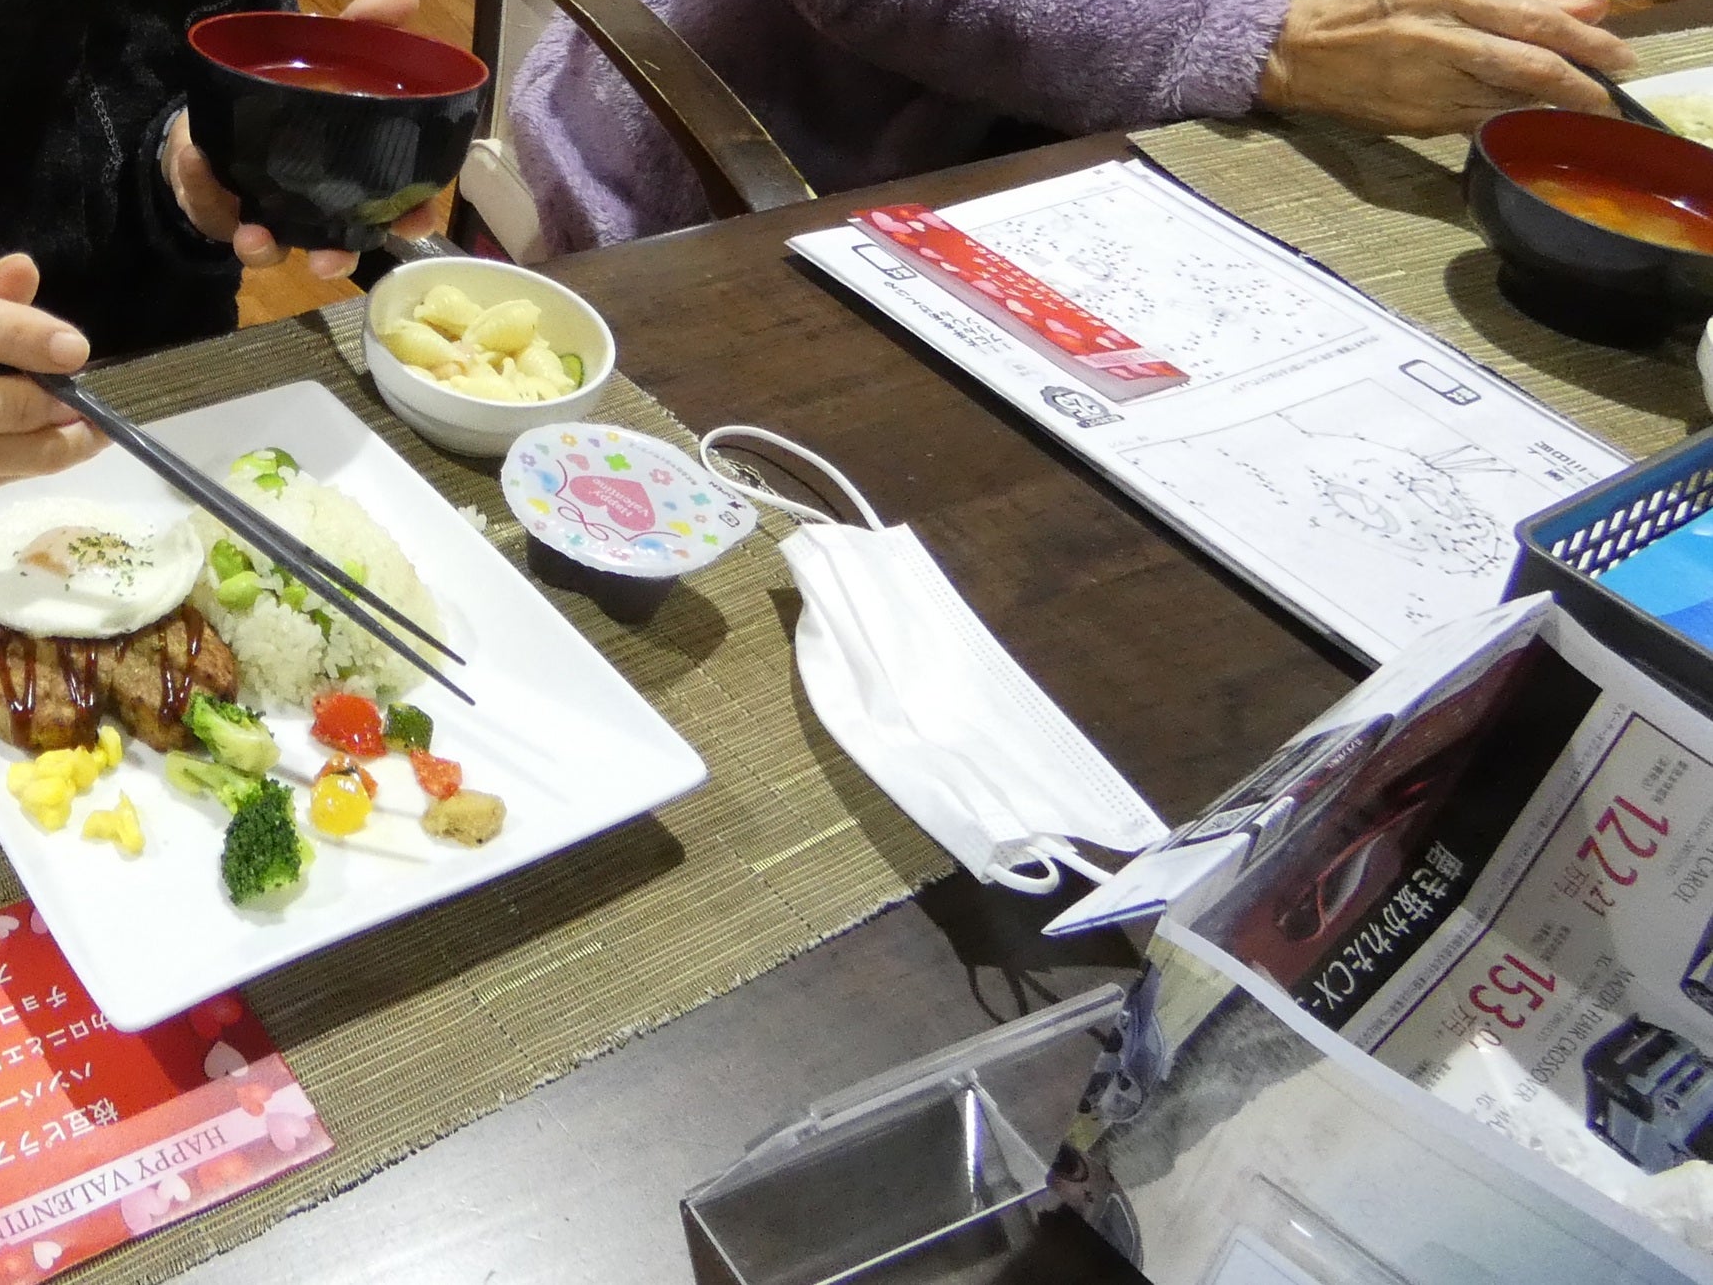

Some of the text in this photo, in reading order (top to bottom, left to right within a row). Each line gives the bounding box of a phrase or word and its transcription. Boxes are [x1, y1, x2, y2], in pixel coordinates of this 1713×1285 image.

[708, 481, 736, 500] OPEN
[1591, 964, 1634, 1013] MAZDA
[1513, 1034, 1577, 1103] CROSSOVER
[133, 1124, 226, 1179] HAPPY
